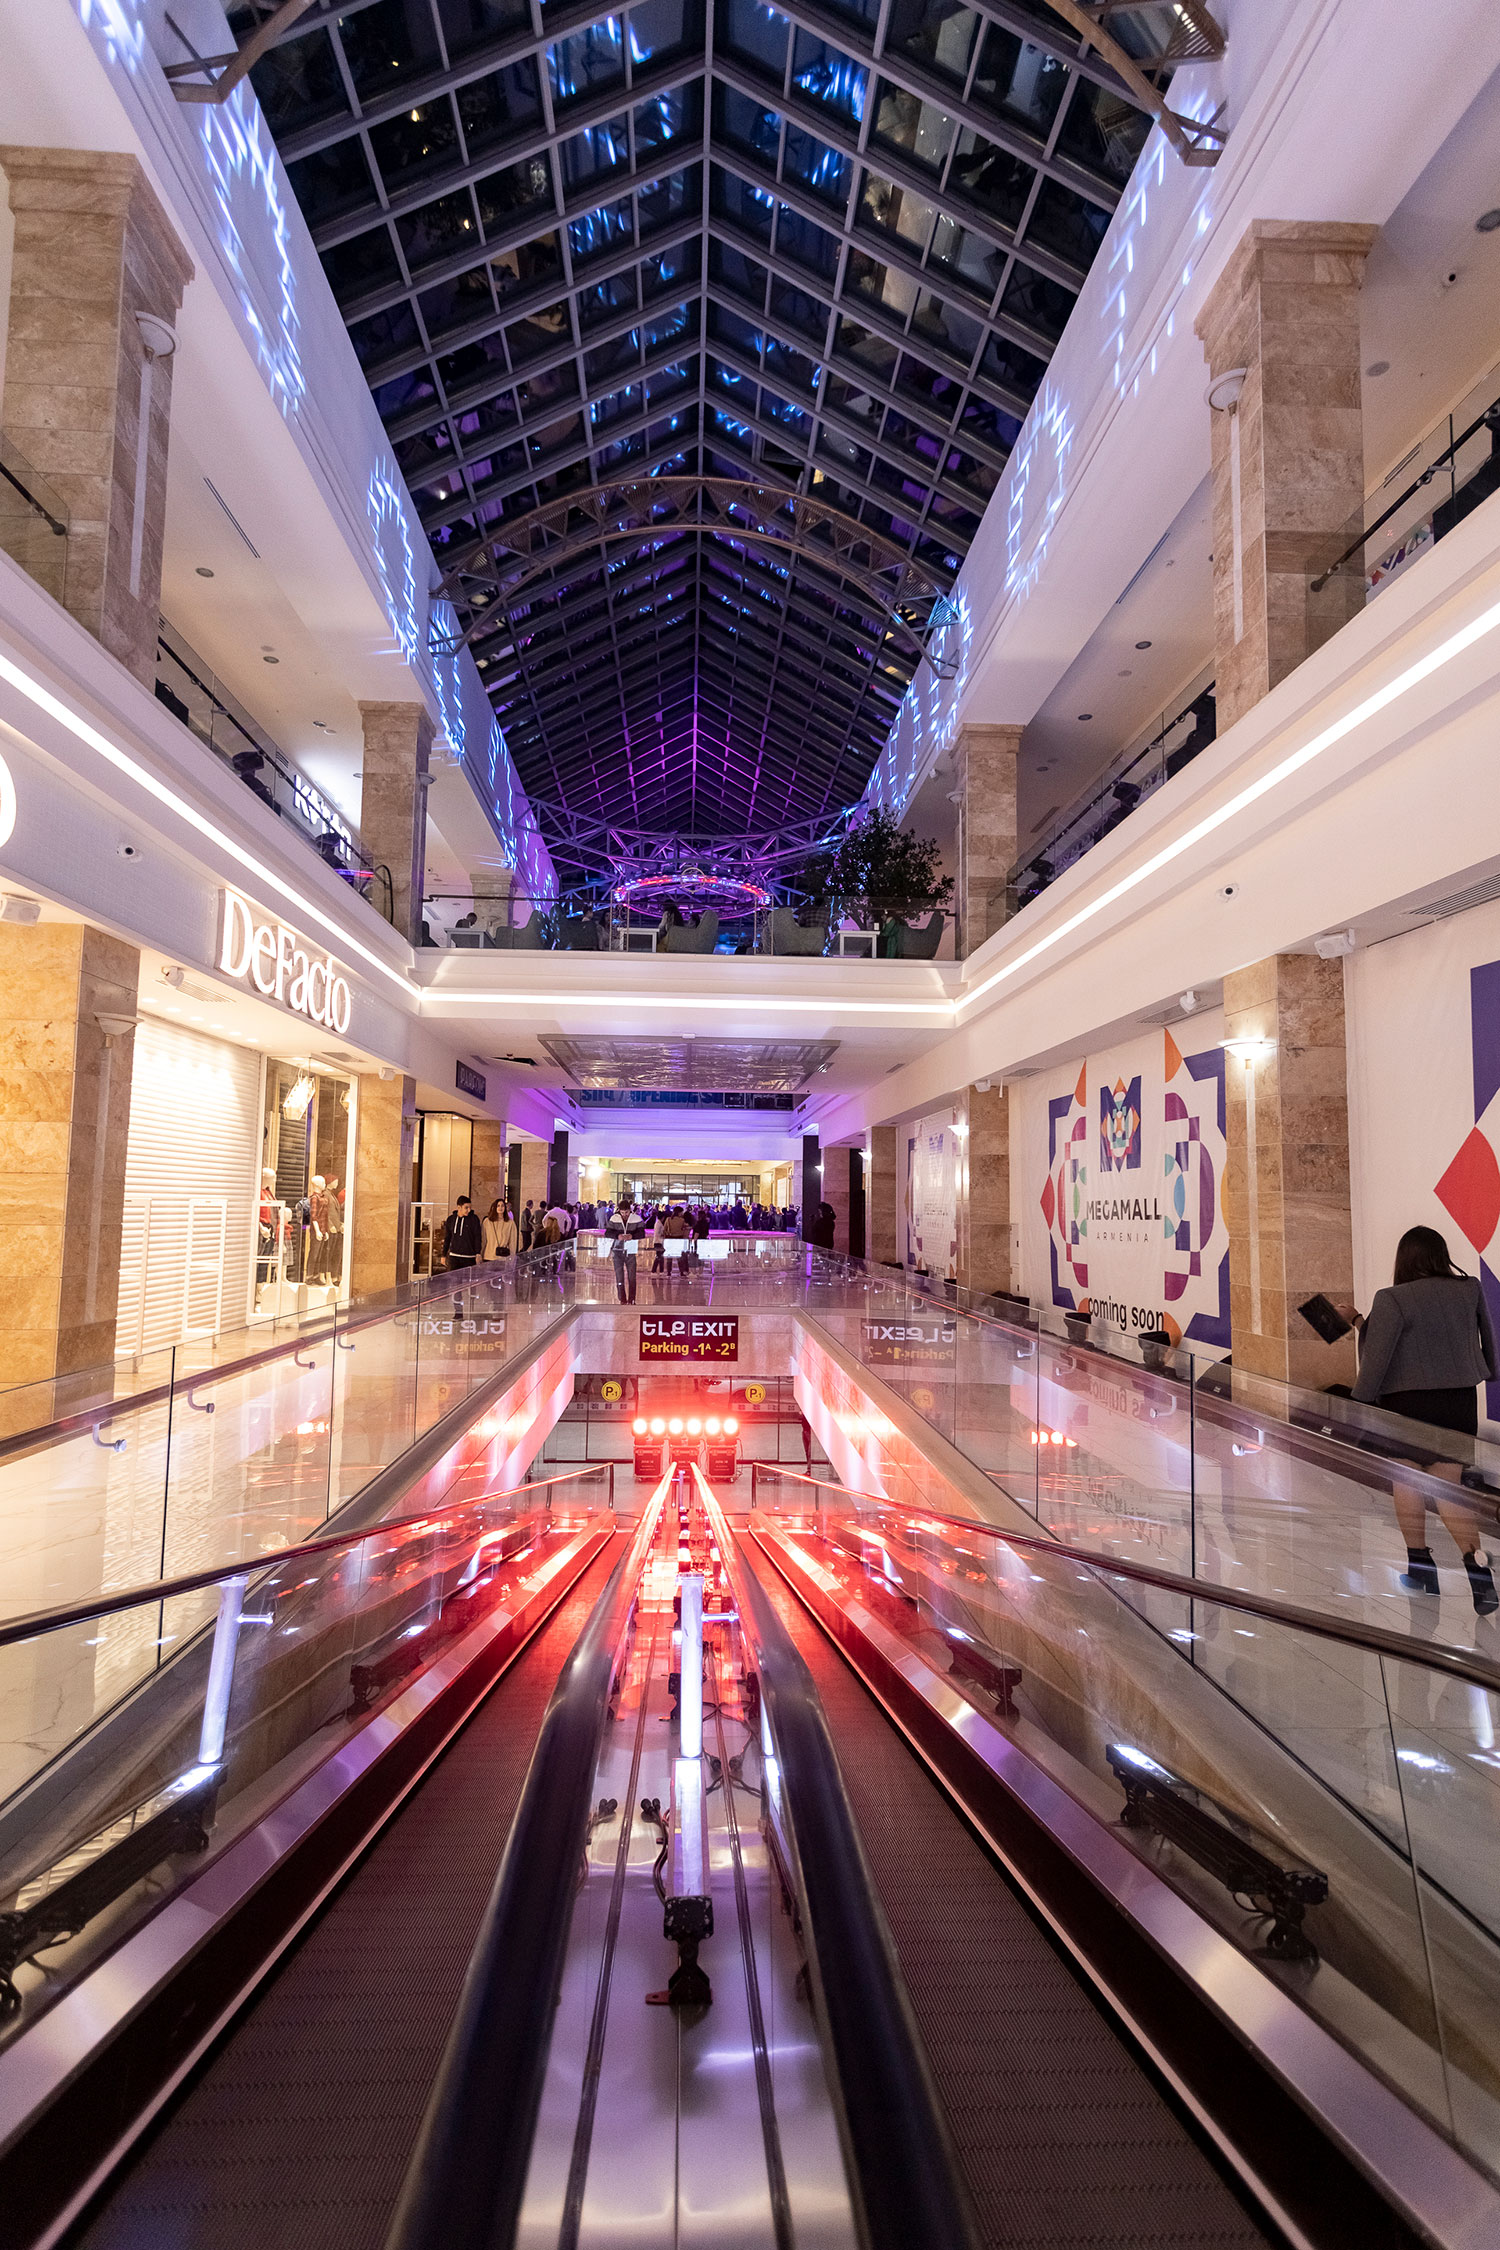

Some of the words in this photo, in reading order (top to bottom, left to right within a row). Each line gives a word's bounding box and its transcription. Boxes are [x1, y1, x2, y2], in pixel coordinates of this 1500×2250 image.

[217, 888, 351, 1034] DeFacto
[1086, 1197, 1162, 1221] MEGAMALL
[1096, 1231, 1149, 1243] ARMENIA
[1087, 1295, 1127, 1331] coming
[1131, 1306, 1164, 1333] soon
[692, 1322, 736, 1337] EXIT
[641, 1341, 690, 1356] Parking
